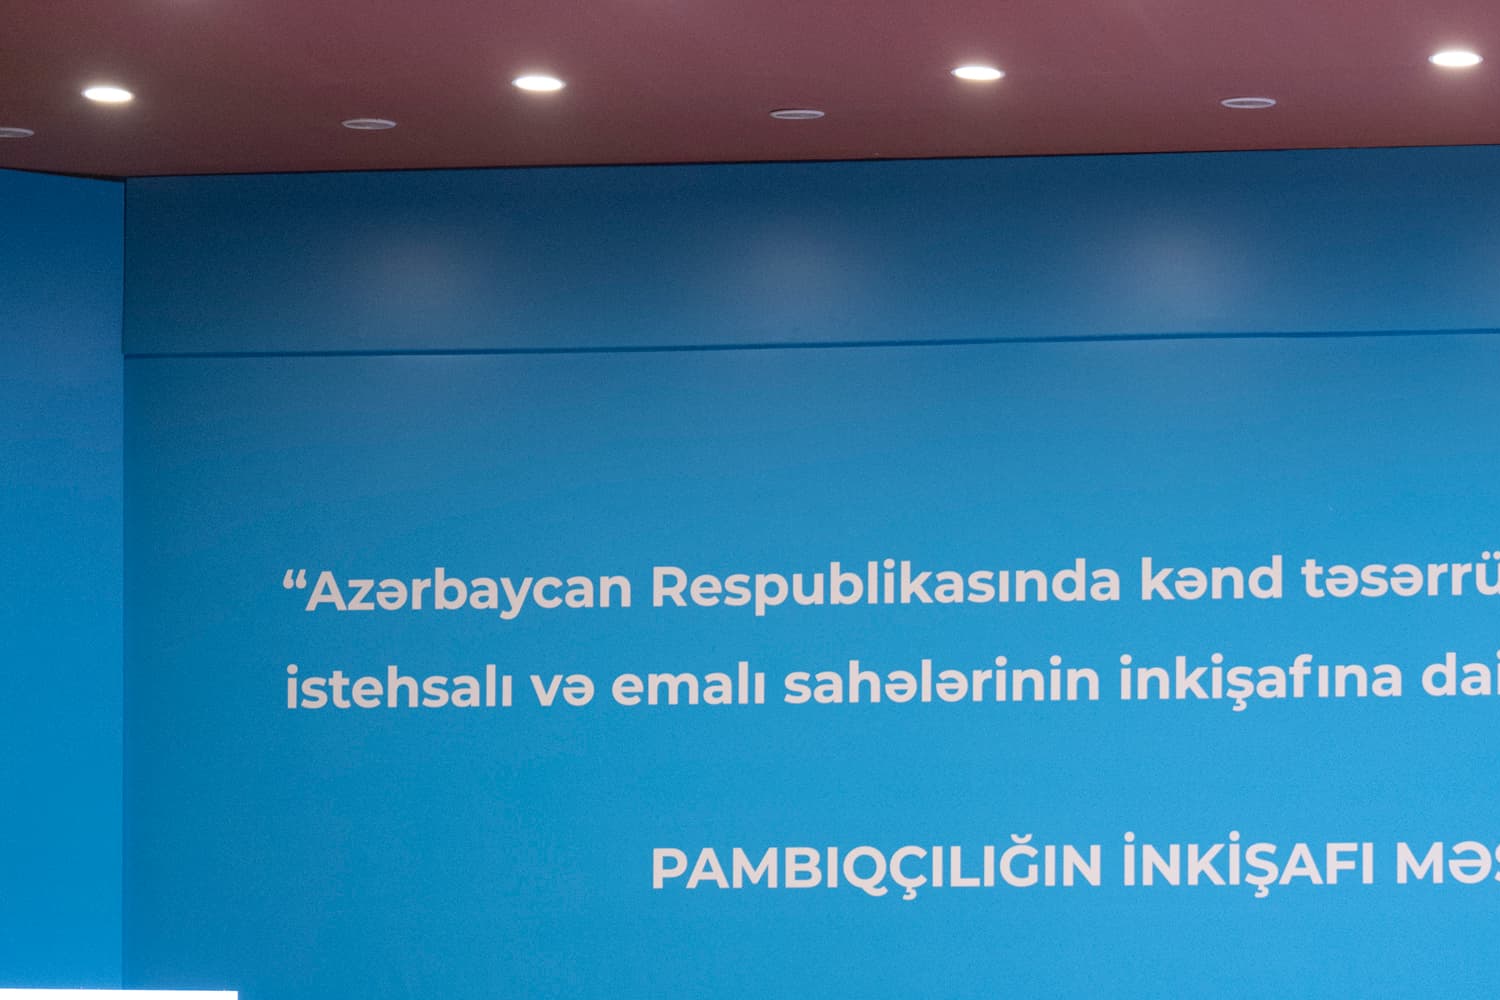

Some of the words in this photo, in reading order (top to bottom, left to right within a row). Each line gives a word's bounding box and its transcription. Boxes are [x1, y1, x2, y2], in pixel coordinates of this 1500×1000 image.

[283, 567, 631, 620] “Azərbaycan
[653, 557, 1120, 617] Respublikasında
[1141, 554, 1283, 602] kənd
[287, 664, 512, 709] istehsalı
[530, 674, 595, 707] və
[611, 661, 765, 706] emalı
[784, 655, 1100, 704] sahələrinin
[1119, 652, 1402, 712] inkişafına
[652, 833, 1101, 901] PAMBIQÇILIĞIN
[1123, 830, 1374, 899] İNKİŞAFI
